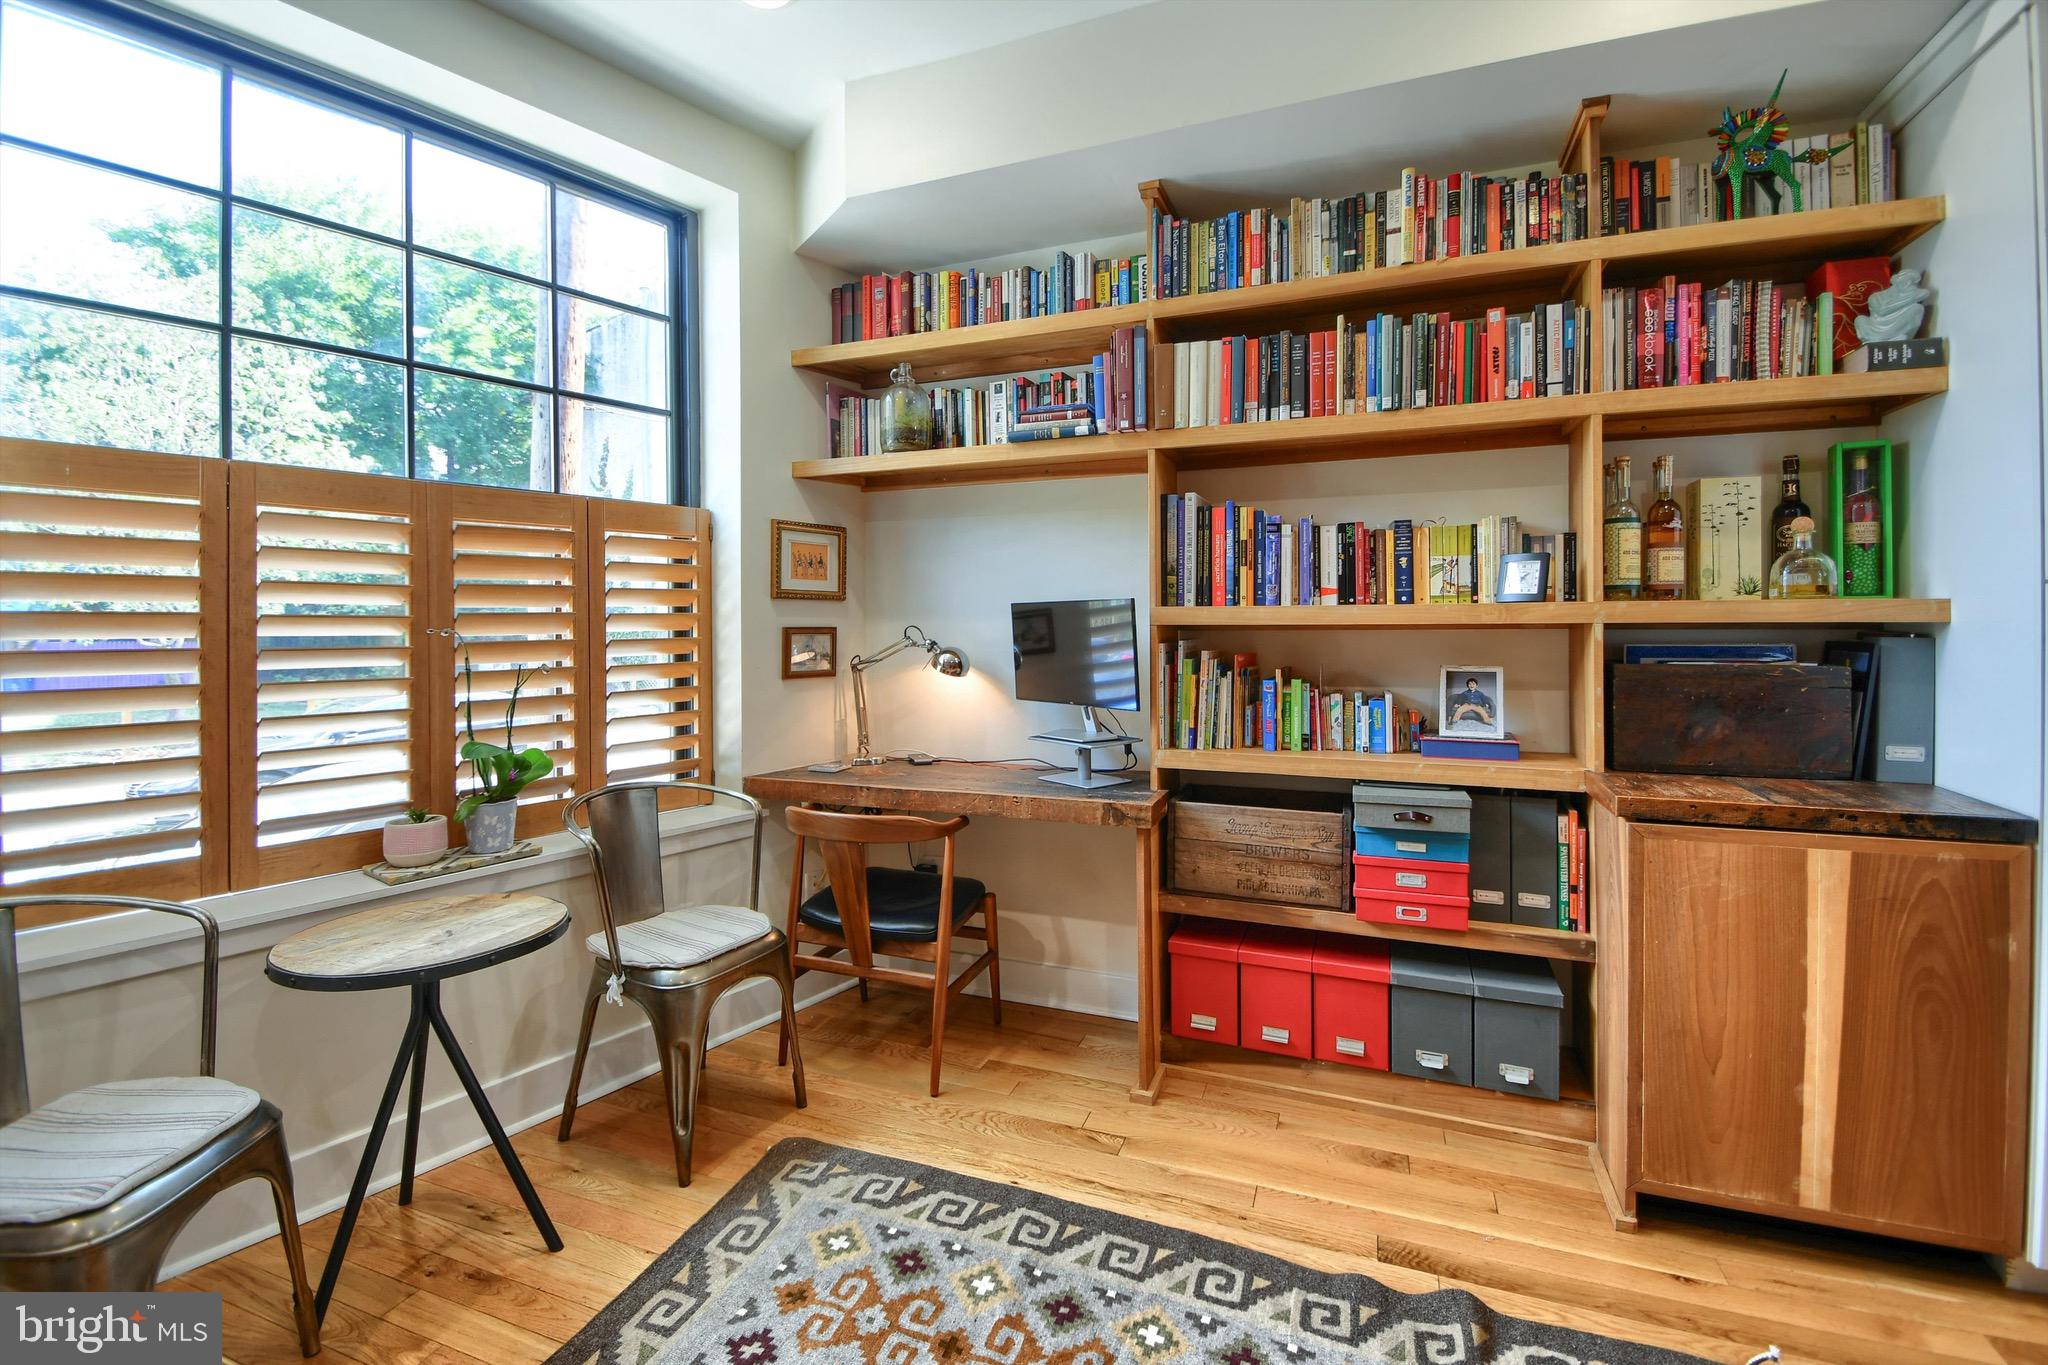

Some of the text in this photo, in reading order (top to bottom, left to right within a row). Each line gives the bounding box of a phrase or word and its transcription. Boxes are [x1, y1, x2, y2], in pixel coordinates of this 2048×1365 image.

[1404, 174, 1412, 207] OUTLAW
[1416, 206, 1425, 233] CARDS
[1173, 240, 1181, 260] Contest
[1217, 225, 1226, 264] Ben Elton
[1139, 263, 1147, 299] MÉXICO
[1644, 309, 1656, 372] cookbook
[1245, 844, 1311, 860] BREWERS
[1560, 846, 1568, 868] SPANISH
[1560, 868, 1568, 882] VERB
[1560, 882, 1568, 902] TENSES
